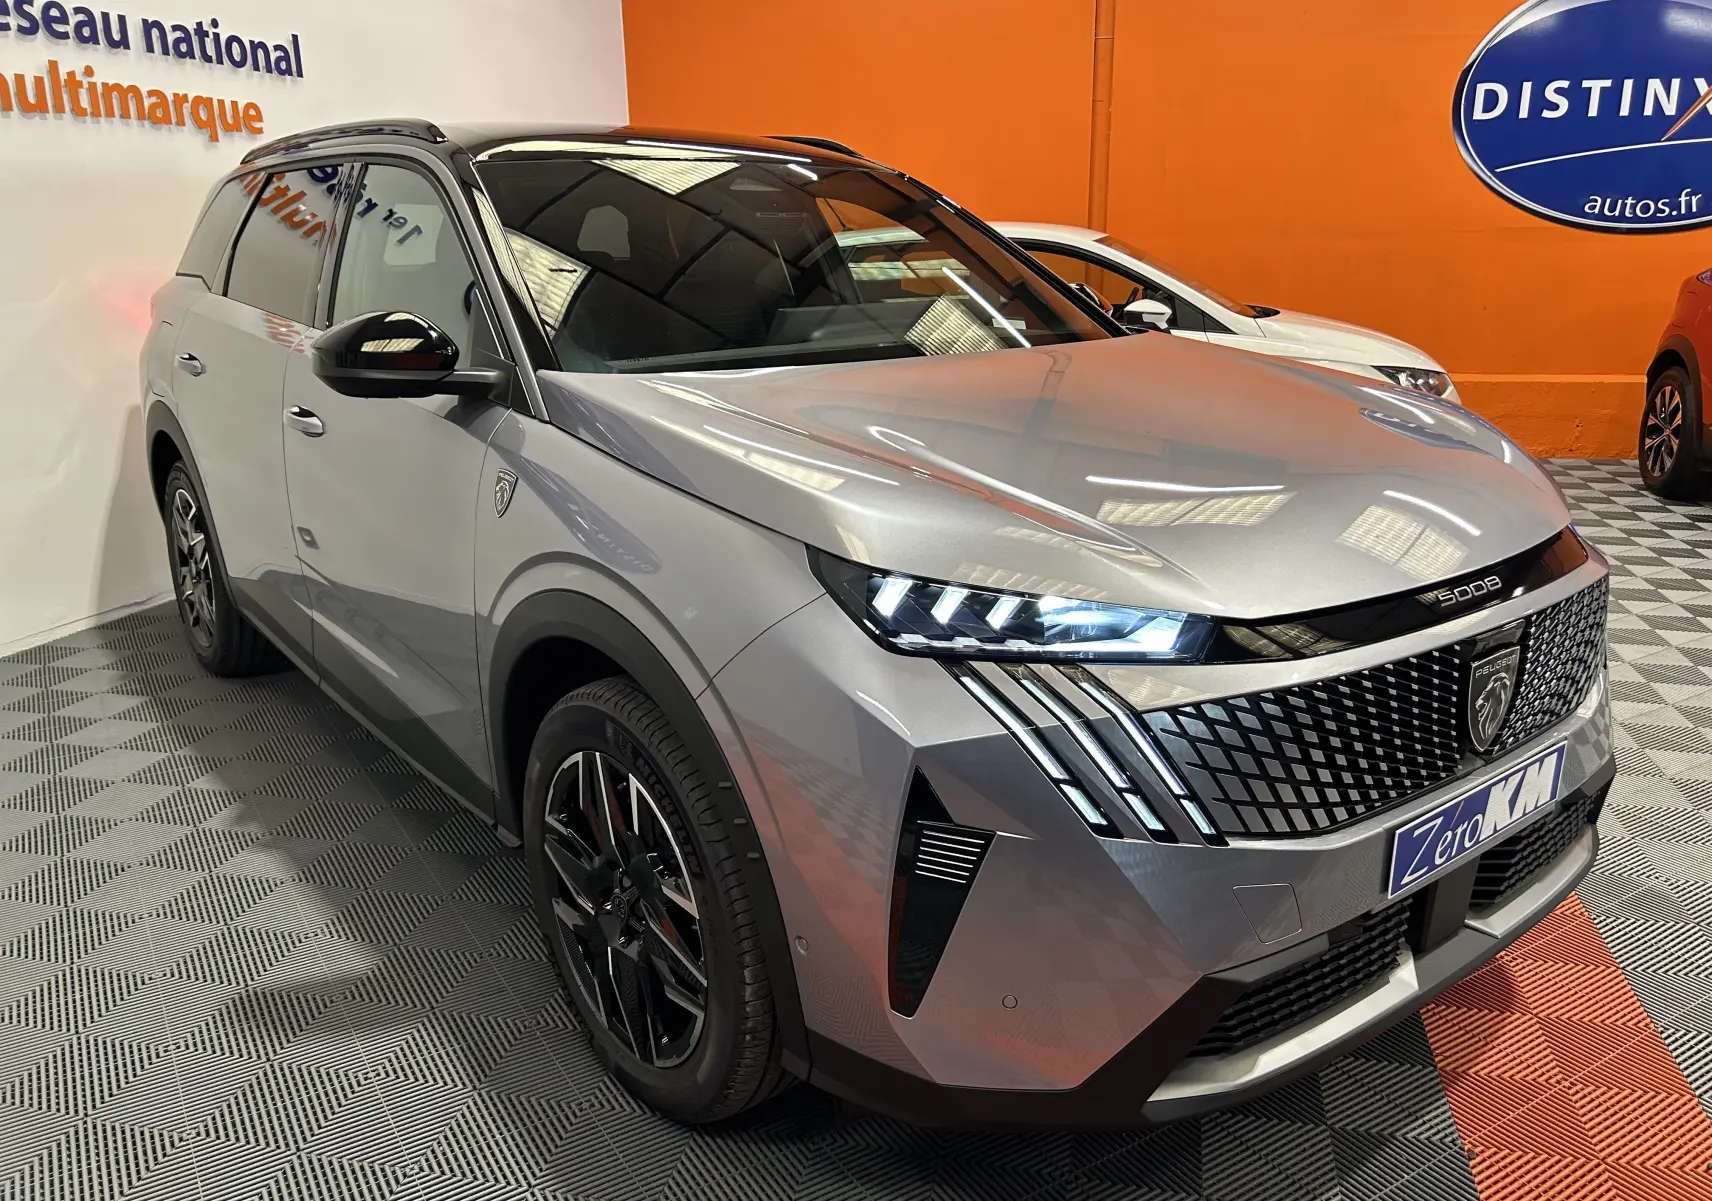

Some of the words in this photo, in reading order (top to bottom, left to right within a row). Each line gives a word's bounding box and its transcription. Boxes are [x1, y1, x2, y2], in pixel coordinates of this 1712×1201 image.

[141, 14, 304, 79] national
[1584, 189, 1702, 218] autos.fr
[1438, 576, 1502, 607] 5008
[1476, 654, 1516, 678] PEUGEOT
